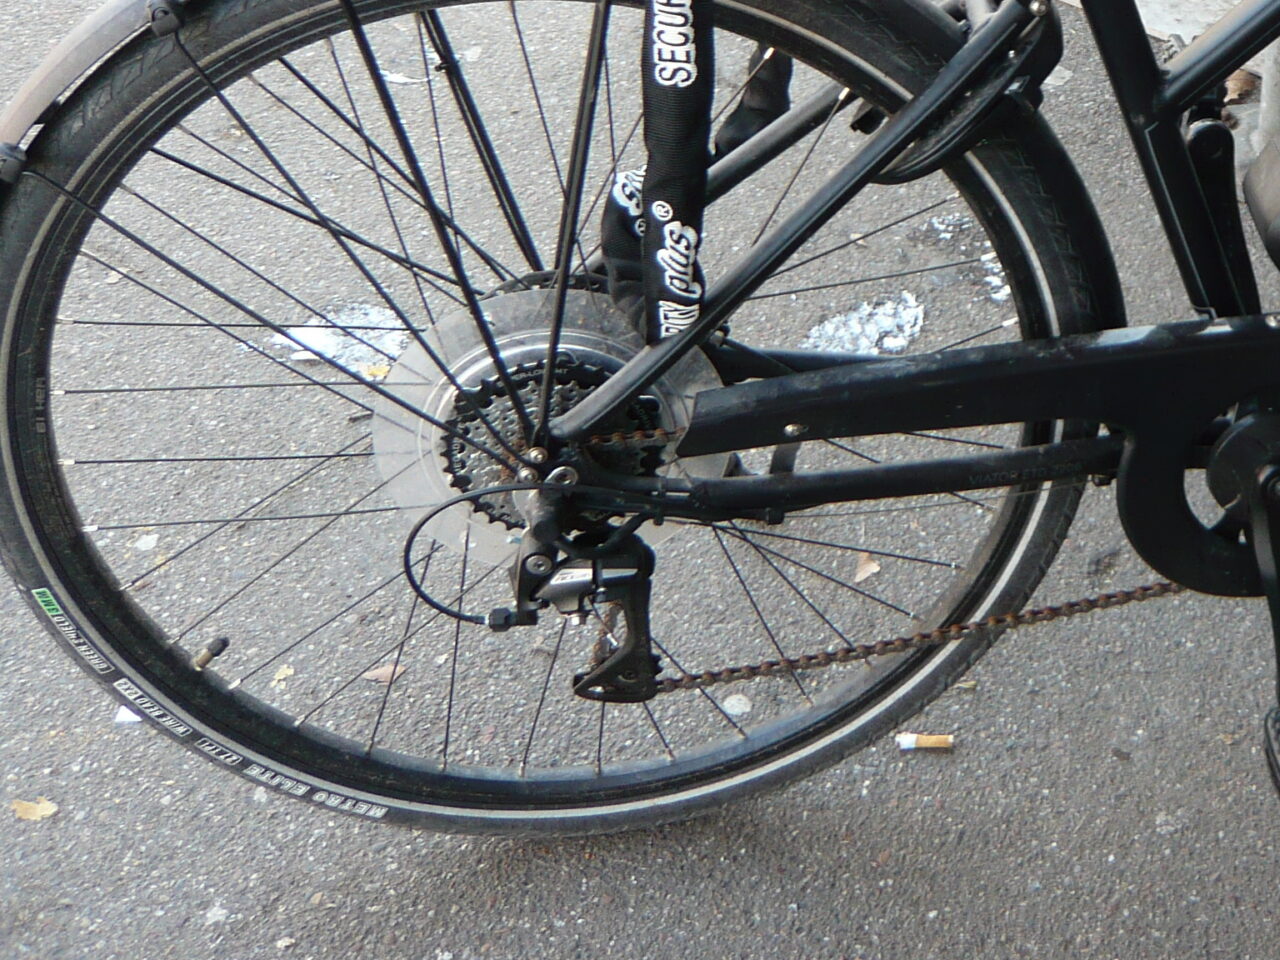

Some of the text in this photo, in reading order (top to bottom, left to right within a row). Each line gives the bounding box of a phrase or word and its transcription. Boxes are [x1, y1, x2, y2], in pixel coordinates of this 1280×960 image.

[657, 221, 702, 298] plus
[54, 616, 84, 644] SHIELD
[77, 644, 108, 668] GREEN
[135, 697, 164, 717] BEAD
[163, 716, 190, 734] WIRE
[243, 763, 389, 819] METRO ELITE
